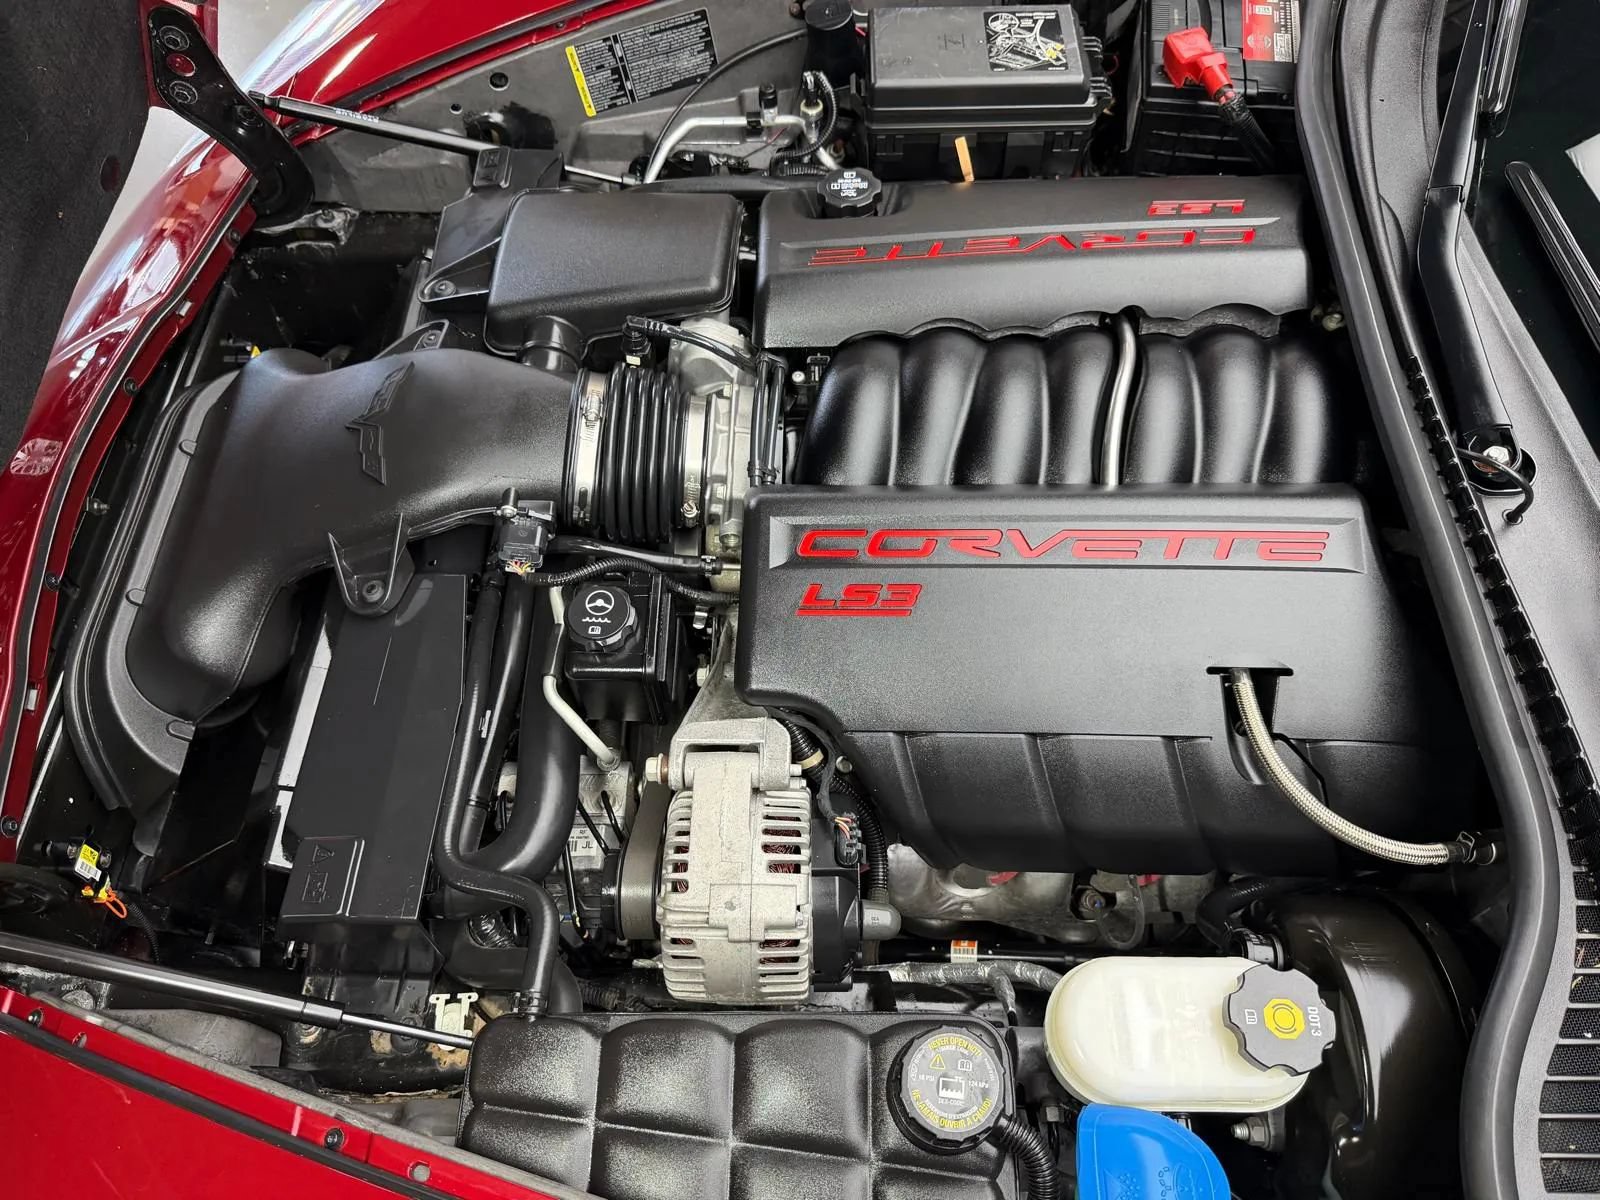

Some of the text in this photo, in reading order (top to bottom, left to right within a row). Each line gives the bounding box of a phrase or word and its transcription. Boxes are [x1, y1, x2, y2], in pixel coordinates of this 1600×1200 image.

[1147, 199, 1246, 217] LS3
[808, 228, 1256, 267] CORVETTE
[796, 528, 1331, 562] CORVETTE
[797, 582, 924, 617] LS3
[1308, 1006, 1322, 1037] DOT 3
[929, 1037, 949, 1050] NEVER
[949, 1037, 968, 1048] OPEN
[918, 1100, 939, 1123] JAMAIS
[939, 1116, 966, 1129] OUVRIR
